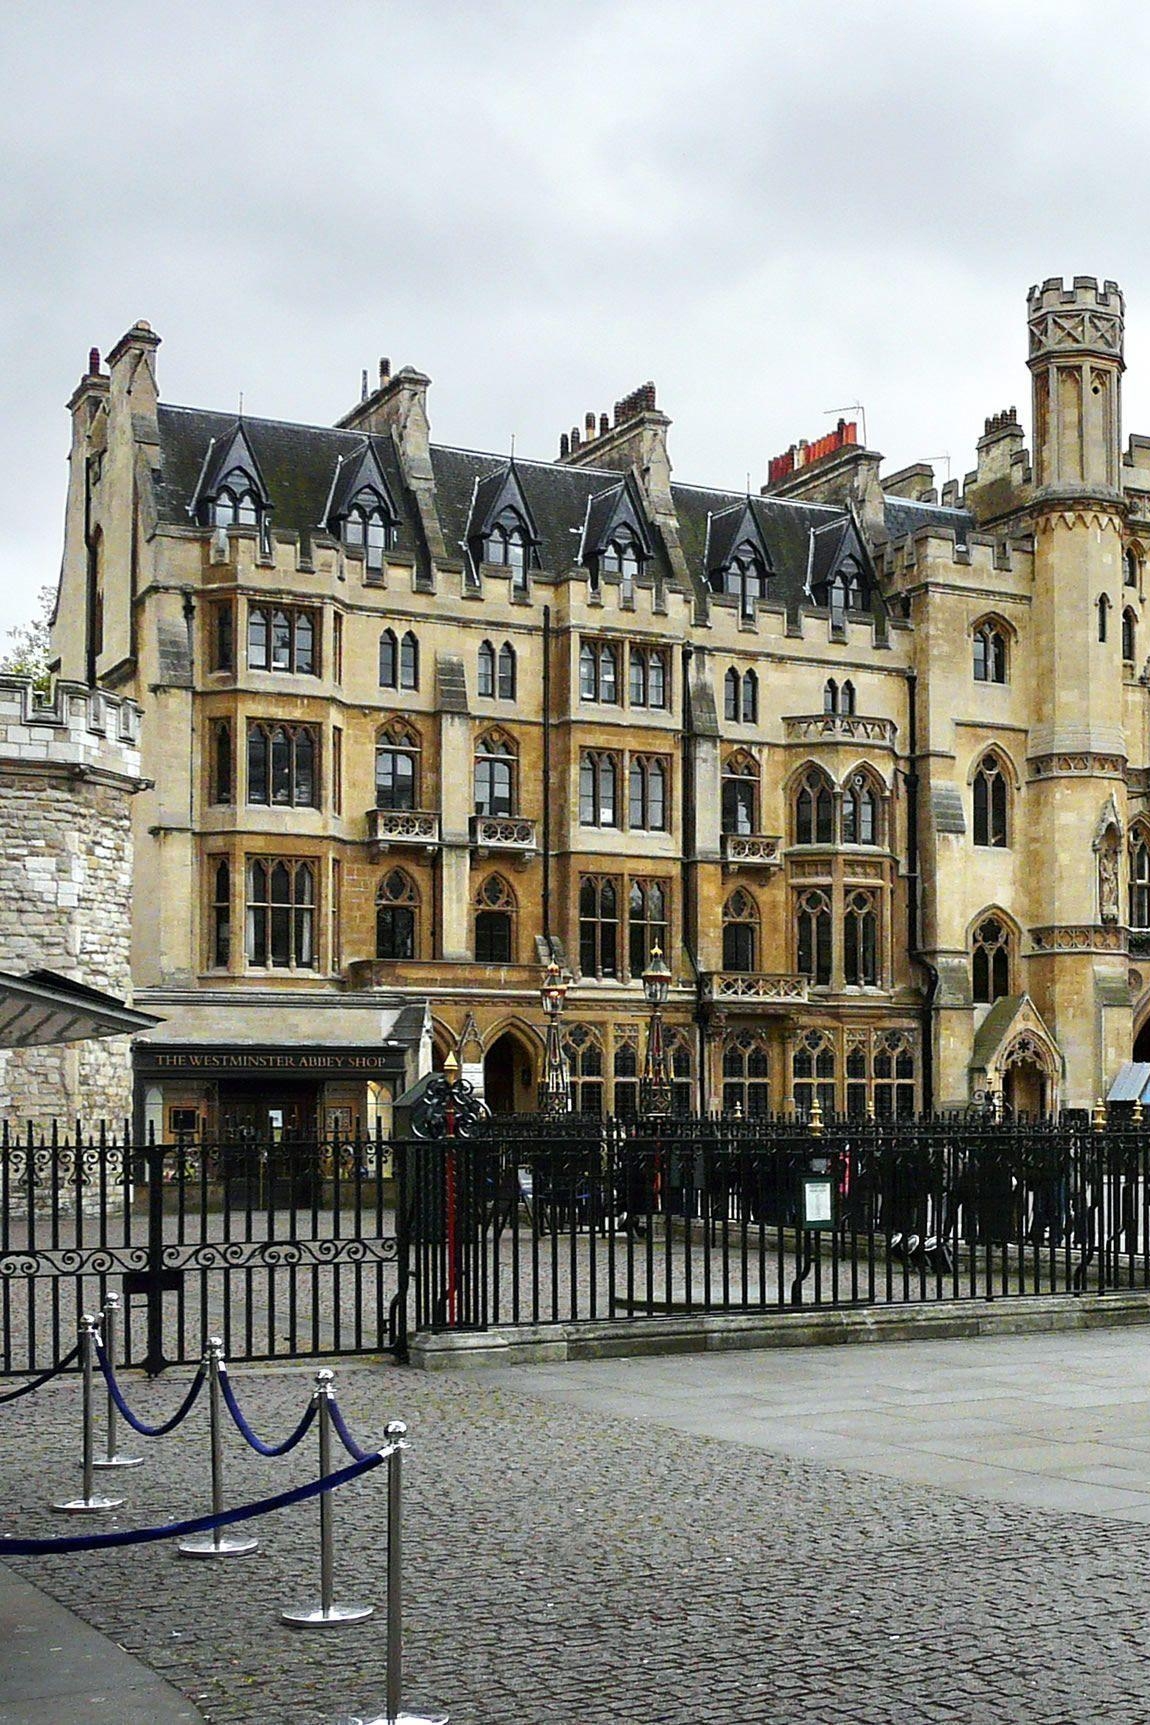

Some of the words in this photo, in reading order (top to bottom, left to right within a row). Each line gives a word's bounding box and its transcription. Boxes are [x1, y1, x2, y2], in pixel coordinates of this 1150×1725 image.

[155, 1055, 186, 1065] THE
[188, 1055, 296, 1068] WESTMINSTER
[299, 1056, 344, 1067] ABBEY
[348, 1056, 386, 1067] SHOP
